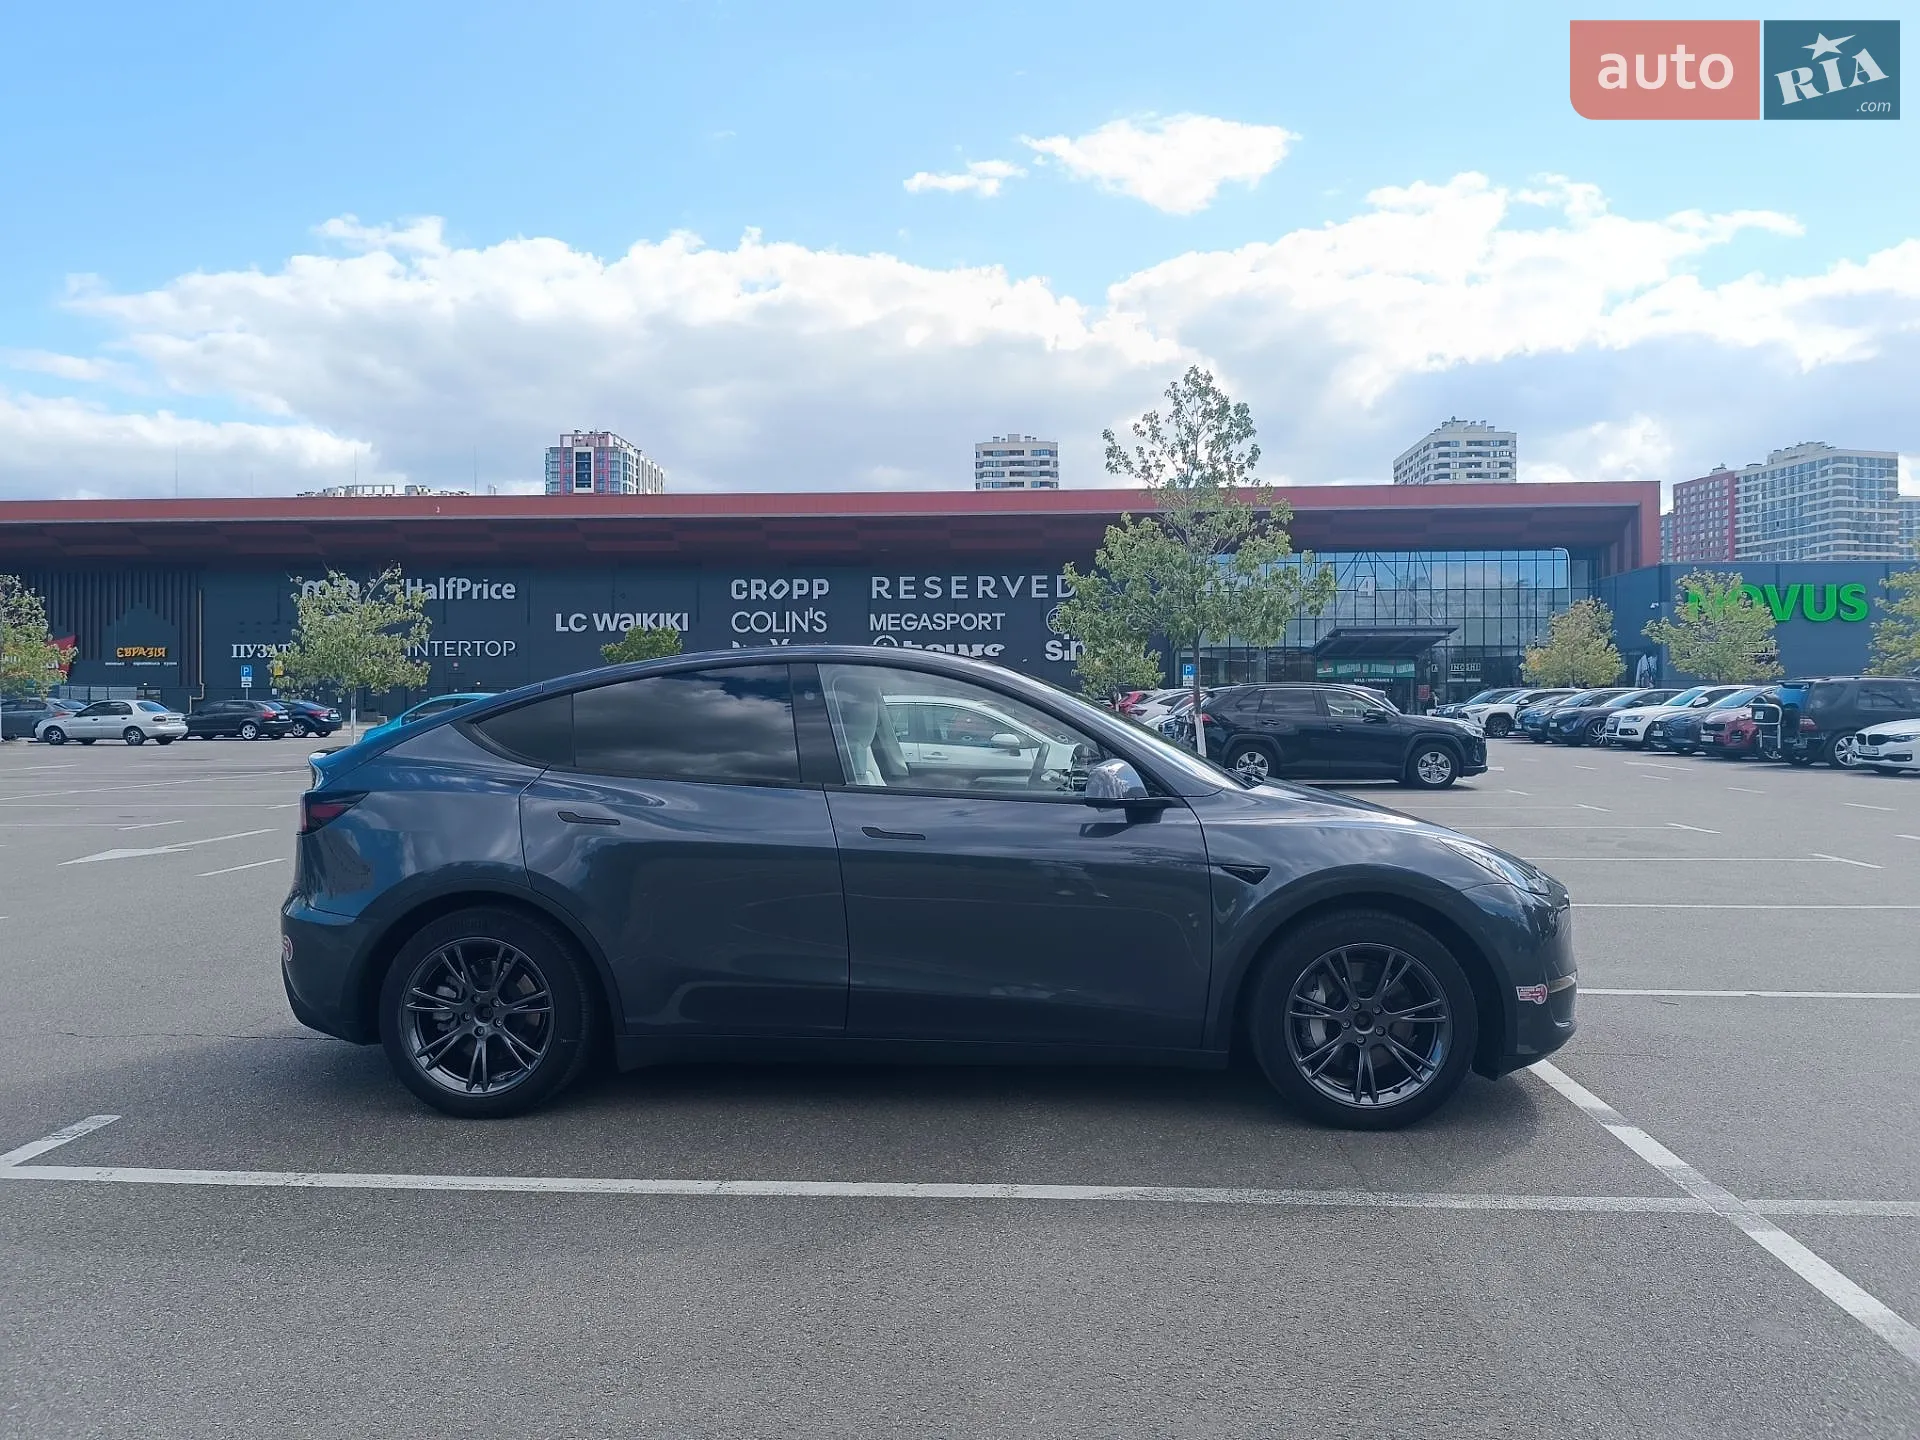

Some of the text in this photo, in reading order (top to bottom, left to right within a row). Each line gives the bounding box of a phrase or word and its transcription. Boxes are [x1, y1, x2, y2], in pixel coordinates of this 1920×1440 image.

[406, 577, 516, 600] HalfPrice
[731, 579, 829, 600] CROPP
[871, 576, 1076, 599] RESERVED
[555, 613, 588, 632] LC
[731, 607, 828, 633] COLIN'S
[869, 612, 1006, 631] MEGASPORT
[231, 643, 291, 658] ПУЗАТ
[407, 641, 516, 657] INTERTOP
